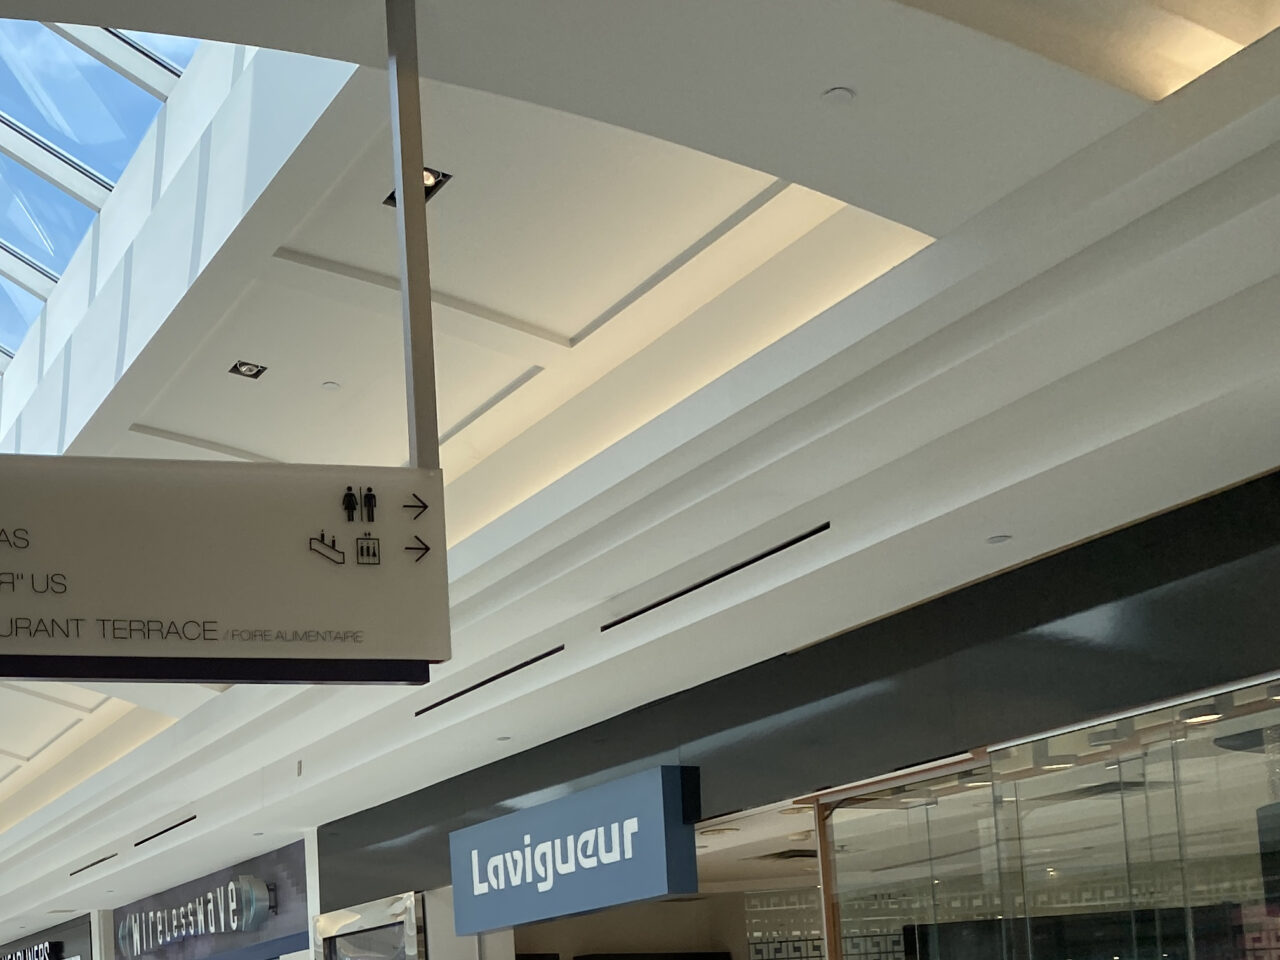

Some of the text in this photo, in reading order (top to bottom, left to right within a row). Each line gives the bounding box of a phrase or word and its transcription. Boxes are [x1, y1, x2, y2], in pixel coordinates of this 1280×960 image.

[31, 573, 67, 594] US
[96, 618, 219, 641] TERRACE
[231, 629, 273, 642] FOIRE
[275, 629, 365, 644] ALIMENTAIRE
[471, 816, 639, 896] Lavigueur
